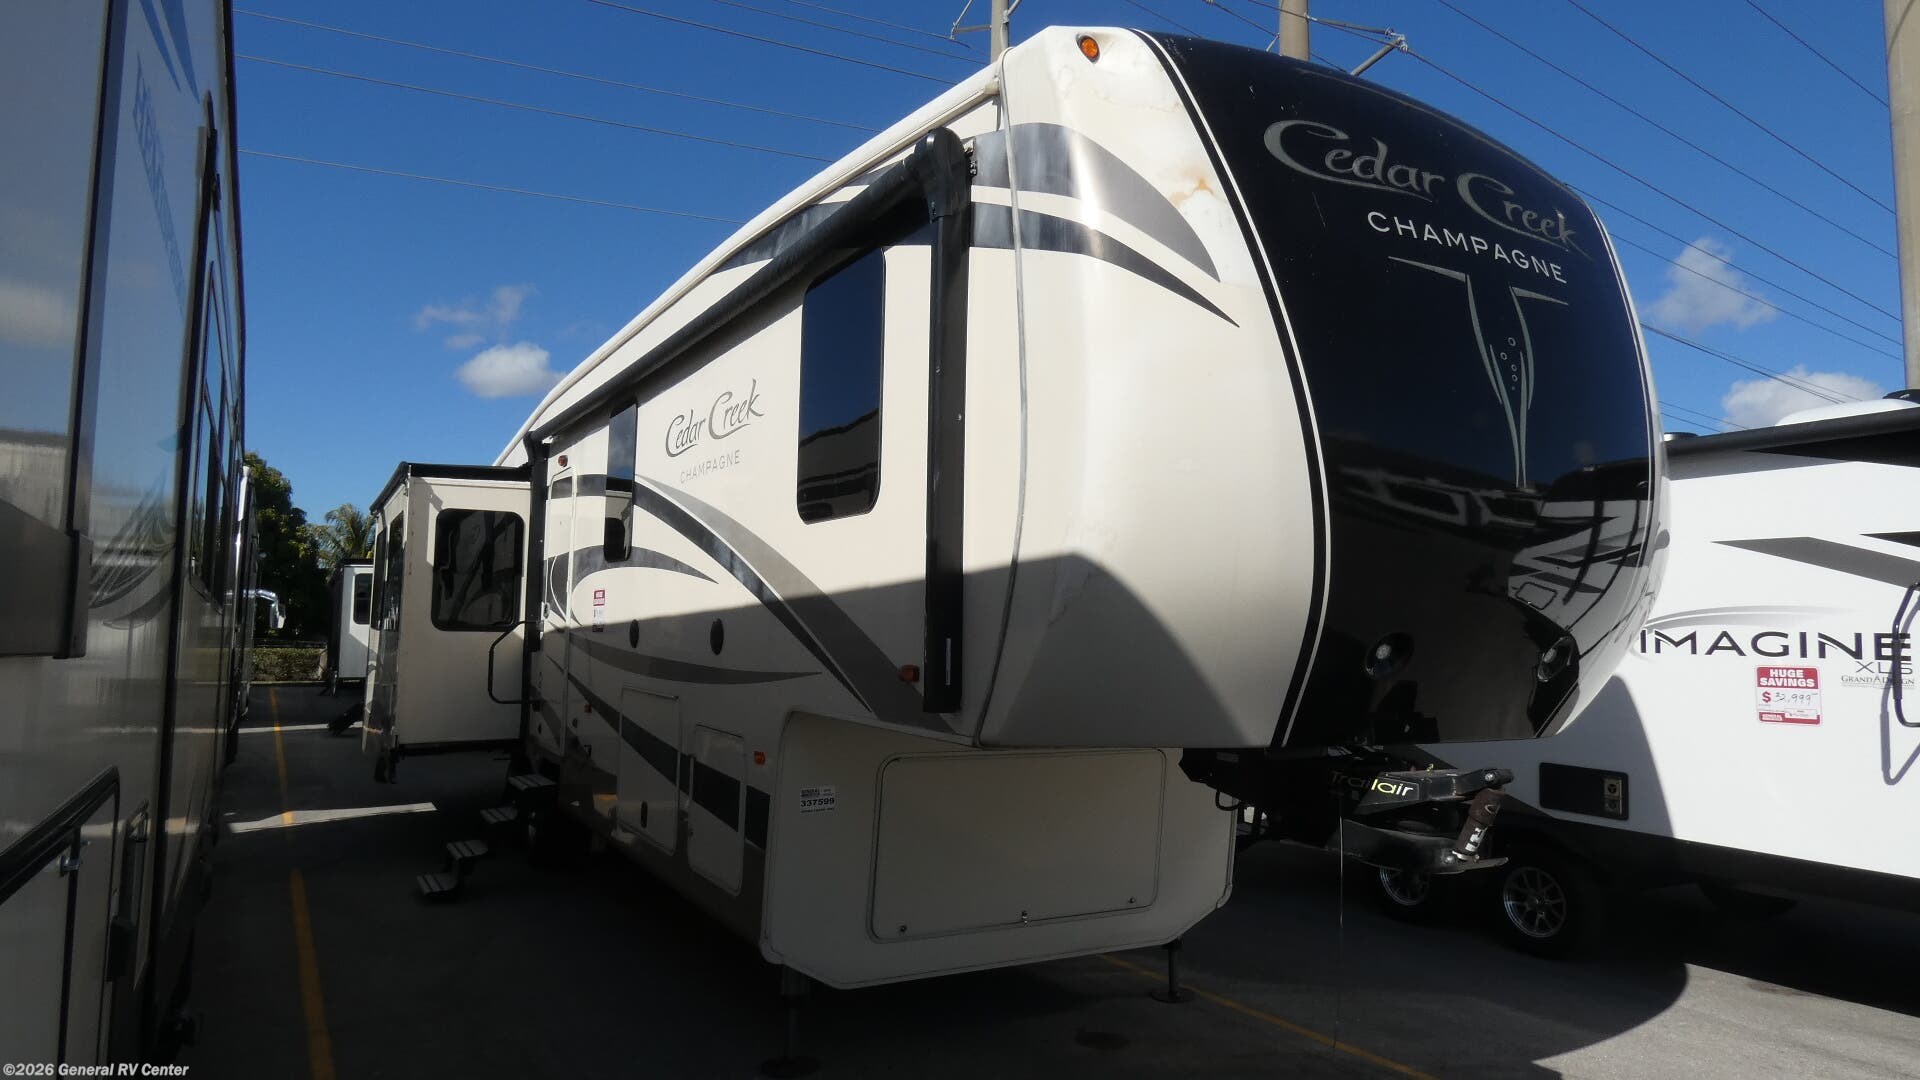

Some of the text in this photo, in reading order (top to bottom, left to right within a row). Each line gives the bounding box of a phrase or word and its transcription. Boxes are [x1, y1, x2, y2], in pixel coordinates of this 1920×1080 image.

[1263, 119, 1594, 260] Cedar Creek
[1367, 211, 1568, 284] CHAMPAGNE
[665, 378, 765, 458] Cedar Creek
[680, 449, 741, 484] CHAMPAGNE
[1640, 629, 1912, 662] IMAGINE
[1759, 677, 1815, 687] SAVINGS
[1769, 668, 1804, 678] HUGE
[1761, 690, 1772, 703] $
